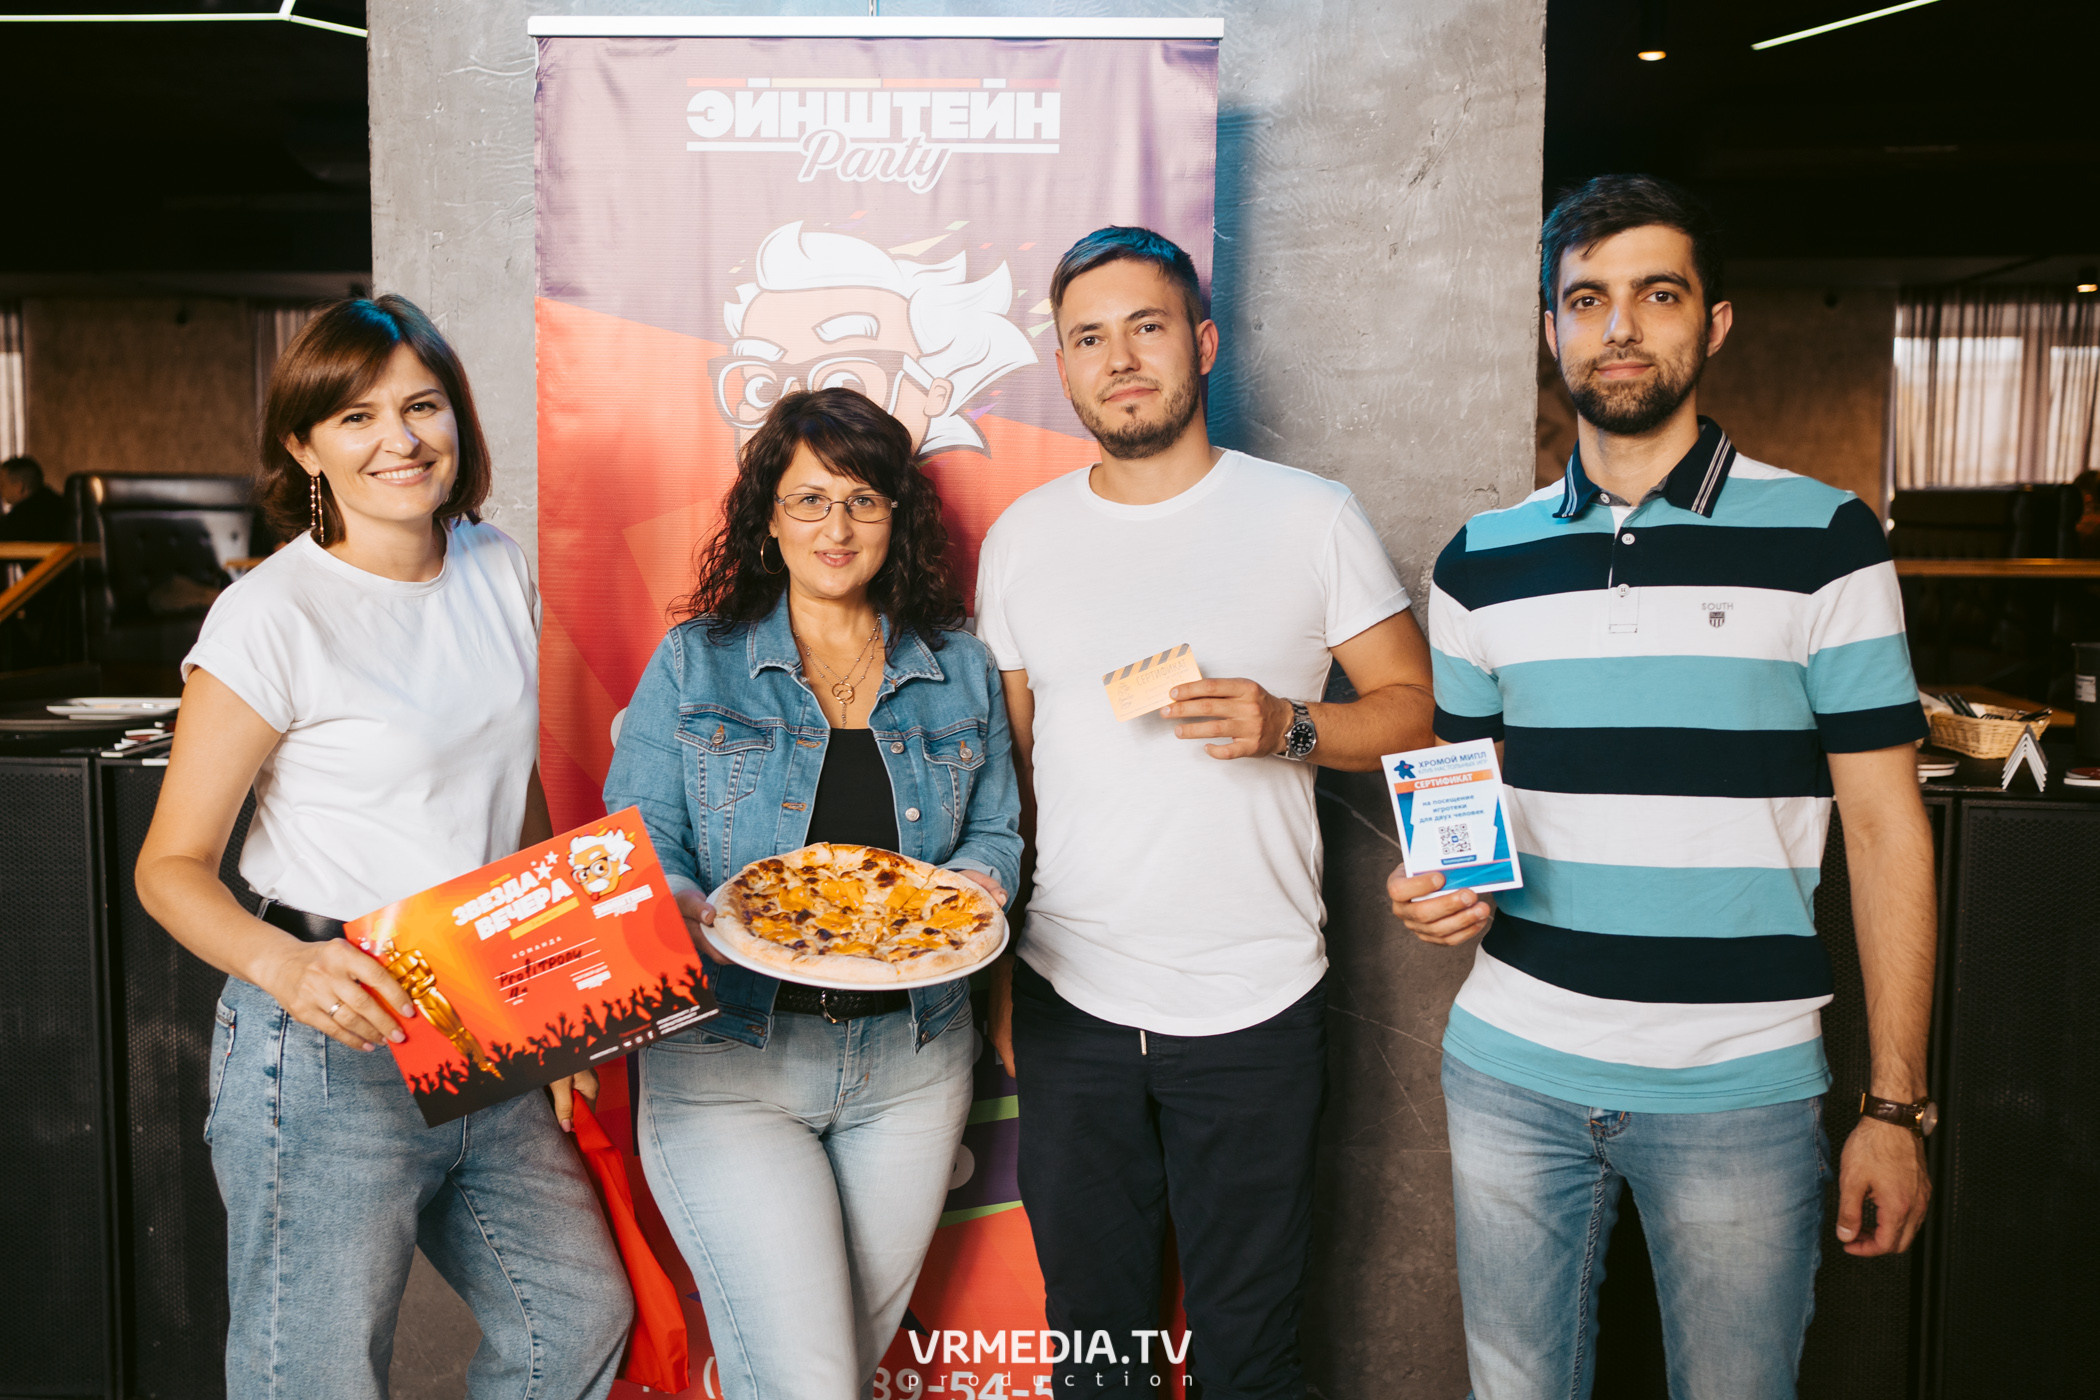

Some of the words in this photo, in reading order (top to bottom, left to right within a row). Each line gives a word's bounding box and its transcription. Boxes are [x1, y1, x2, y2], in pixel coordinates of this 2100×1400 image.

[686, 78, 1061, 139] ЭЙНШТЕЙН
[797, 127, 951, 194] Party
[1701, 602, 1734, 610] SOUTH
[1418, 755, 1458, 768] ХРОМОЙ
[1460, 751, 1487, 761] МИПЛ
[1414, 773, 1473, 789] СЕРТИФИКАТ
[1433, 803, 1467, 813] игротеки
[452, 871, 540, 926] ЗВЕЗДА
[474, 878, 574, 941] ВЕЧЕРА
